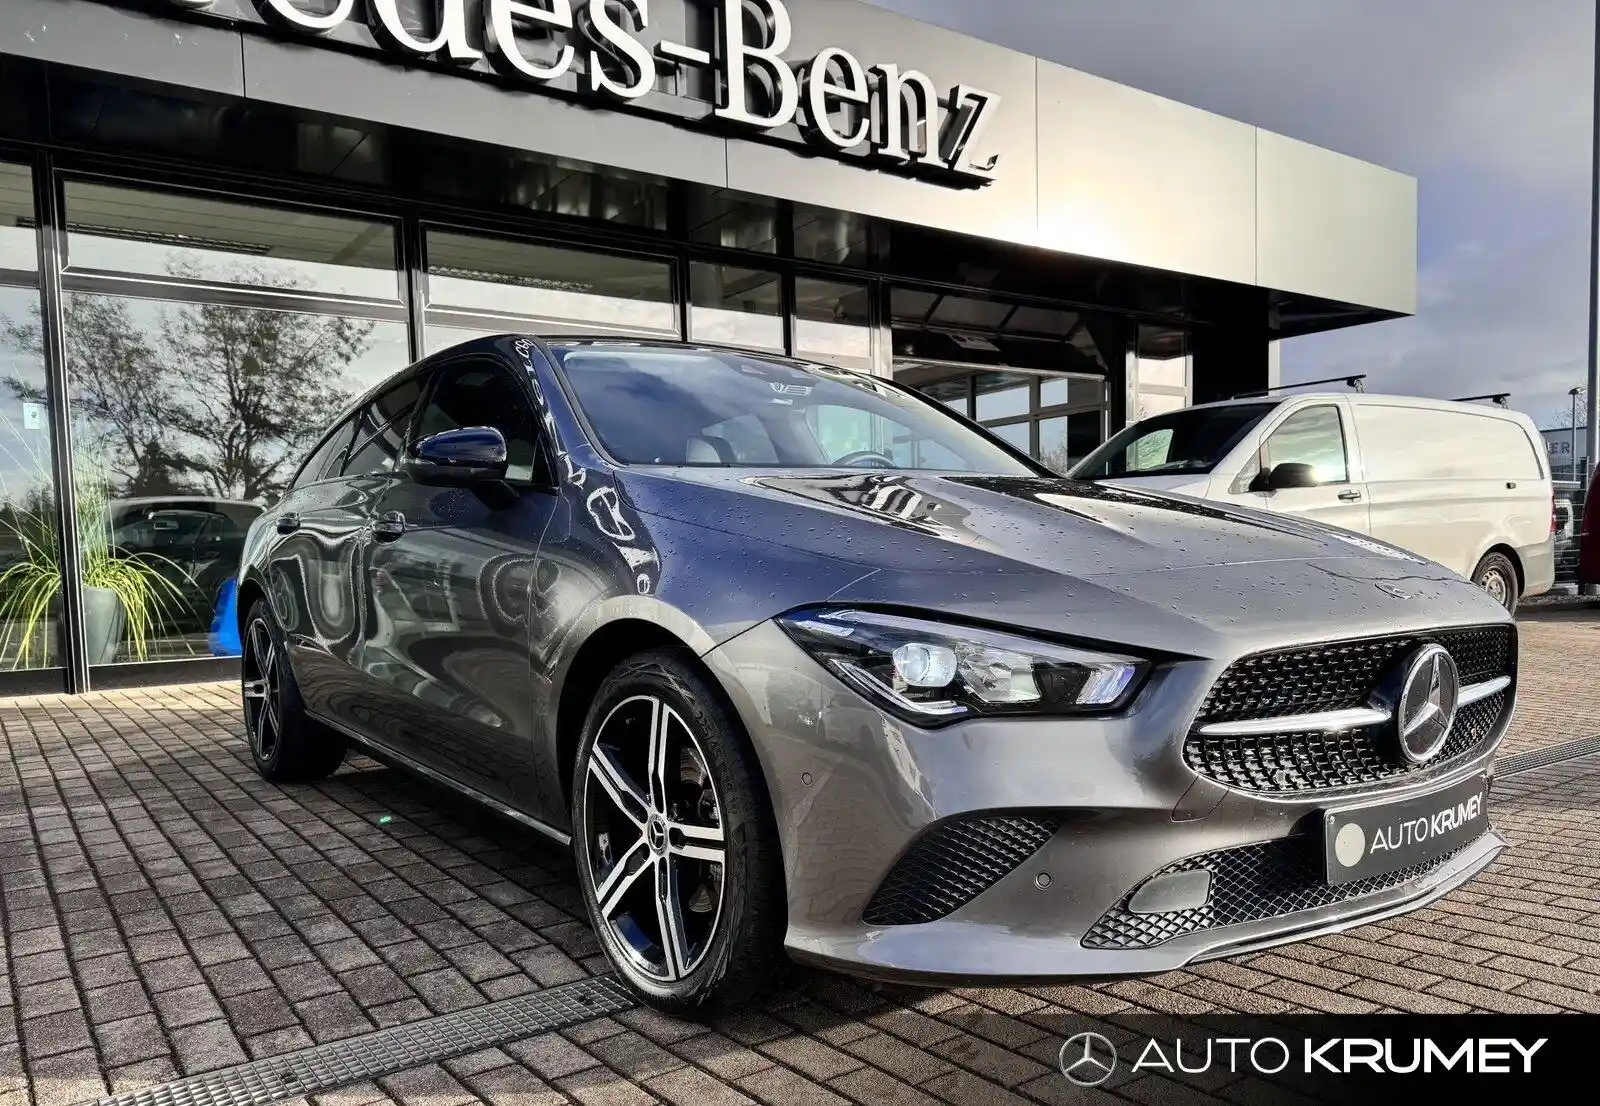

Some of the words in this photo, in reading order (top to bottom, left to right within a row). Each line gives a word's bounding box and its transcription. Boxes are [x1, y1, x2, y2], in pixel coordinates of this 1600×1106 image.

[164, 0, 1002, 181] es-Benz
[1369, 817, 1429, 854] AUTO
[1430, 791, 1483, 838] KRUMEY
